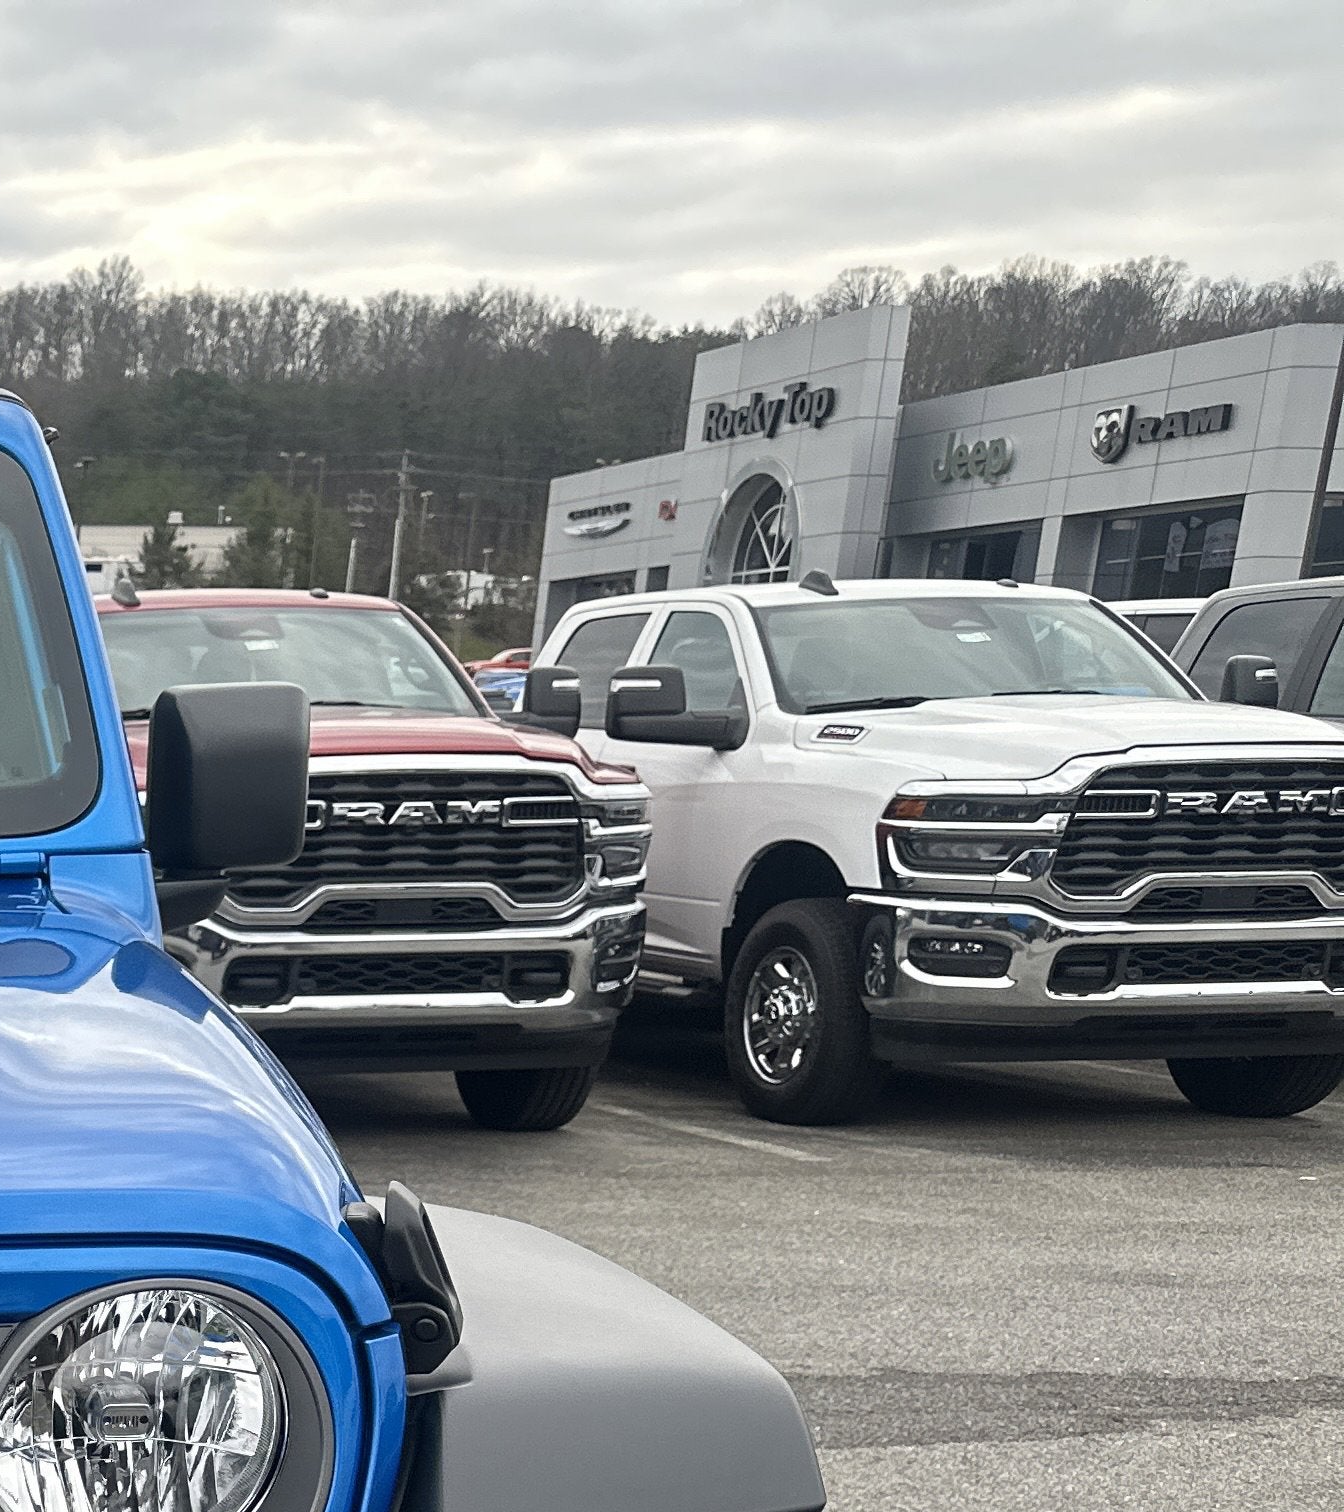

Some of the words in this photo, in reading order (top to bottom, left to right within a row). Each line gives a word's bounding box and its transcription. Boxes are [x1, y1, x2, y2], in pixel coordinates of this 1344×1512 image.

[702, 391, 786, 442] Rocky
[783, 381, 836, 430] Top
[1134, 403, 1233, 444] RAM
[931, 431, 1014, 484] Jeep
[823, 726, 861, 736] 2500
[330, 800, 502, 826] RAM
[1164, 790, 1332, 815] RAM
